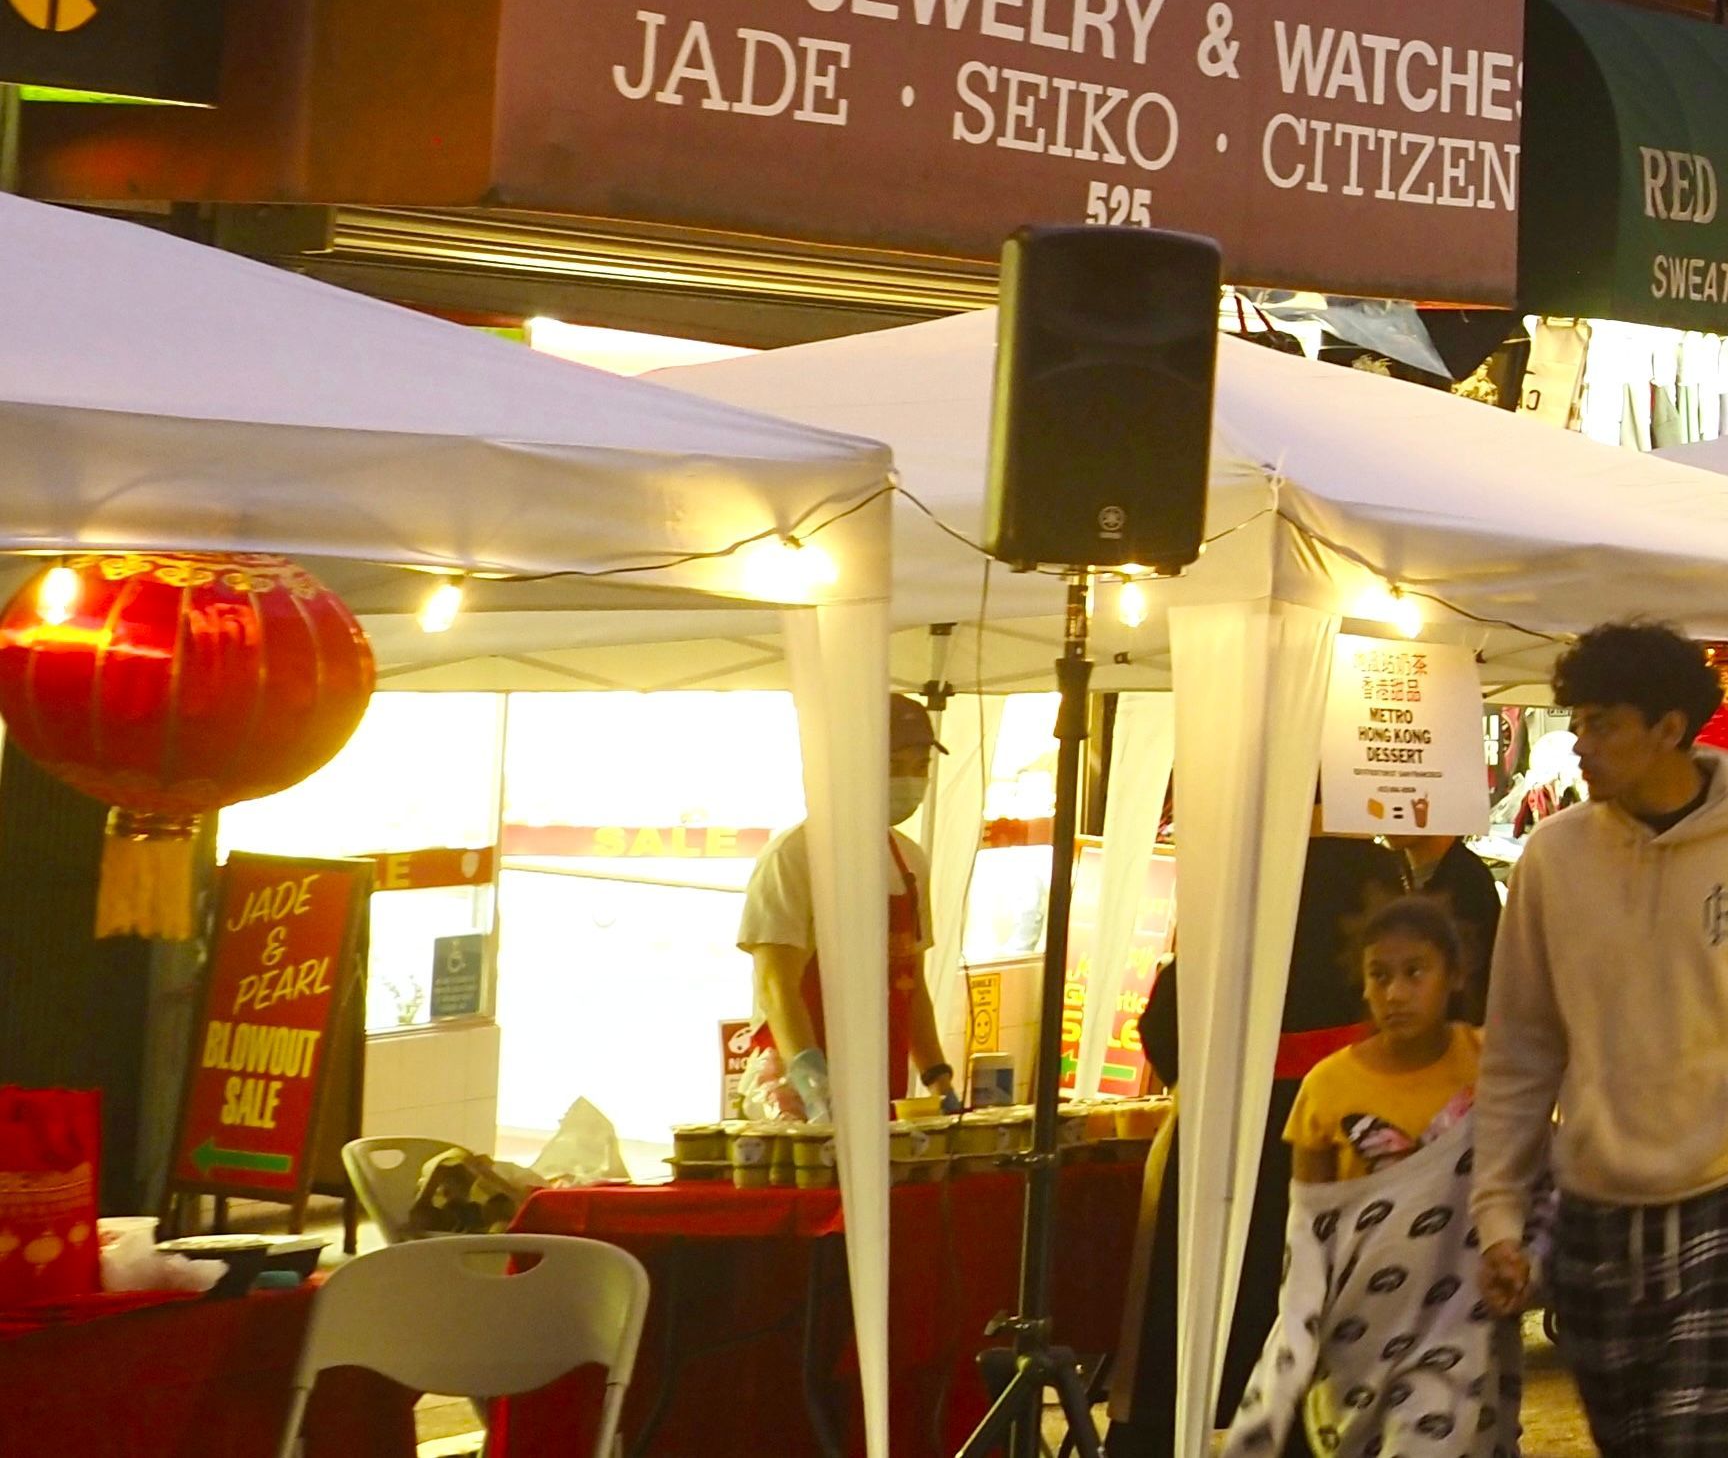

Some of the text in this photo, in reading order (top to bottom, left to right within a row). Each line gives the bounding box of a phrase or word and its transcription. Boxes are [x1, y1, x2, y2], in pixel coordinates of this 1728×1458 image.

[1195, 1, 1242, 82] &
[1273, 18, 1523, 123] WATCHE
[611, 9, 1521, 213] JADE SEIKO CITIZEN
[1085, 182, 1152, 228] 525
[1640, 146, 1718, 224] RED
[1358, 726, 1432, 745] HONG KONG
[1369, 707, 1414, 725] METRO
[1366, 747, 1425, 765] DESSERT
[592, 826, 738, 858] SALE
[227, 873, 320, 932] JADE
[261, 925, 287, 966] &
[231, 956, 332, 1015] PEARL
[202, 1019, 322, 1078] BLOWOUT
[219, 1076, 283, 1129] SALE
